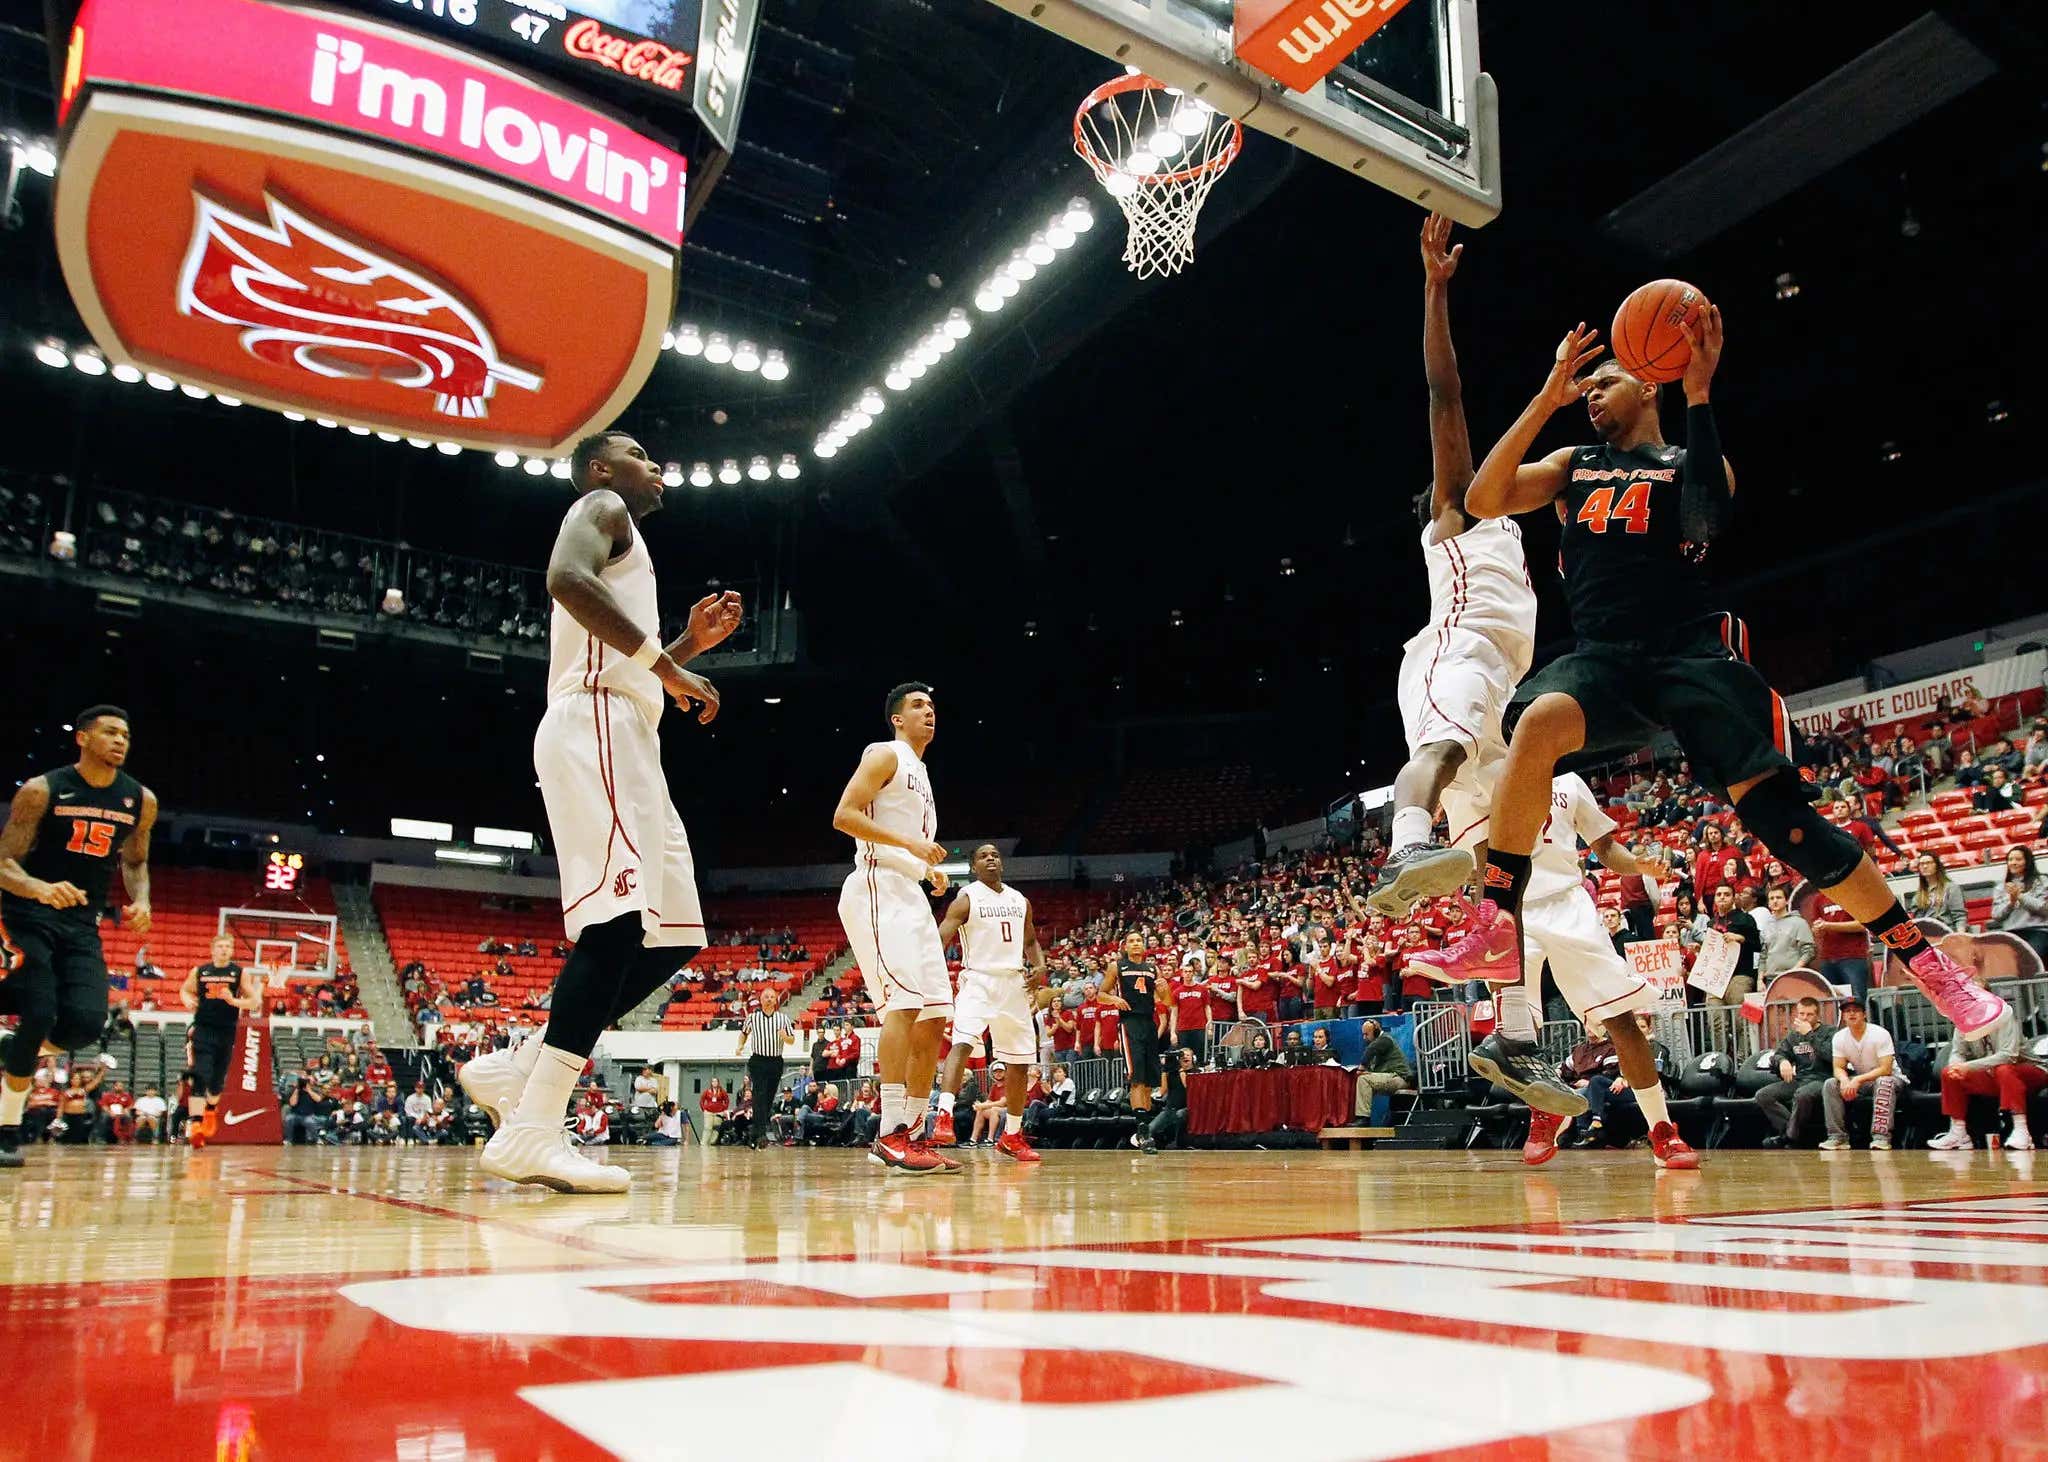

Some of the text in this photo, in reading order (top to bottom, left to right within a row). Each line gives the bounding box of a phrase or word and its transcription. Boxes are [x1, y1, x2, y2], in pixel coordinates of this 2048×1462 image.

[510, 13, 549, 44] 47
[1277, 0, 1398, 64] arm
[1577, 482, 1652, 534] 44
[66, 819, 115, 857] 15
[265, 864, 297, 890] 32
[979, 906, 1024, 919] COUGARS
[1000, 921, 1012, 942] 0
[1635, 952, 1671, 973] BEER
[1134, 976, 1147, 994] 4
